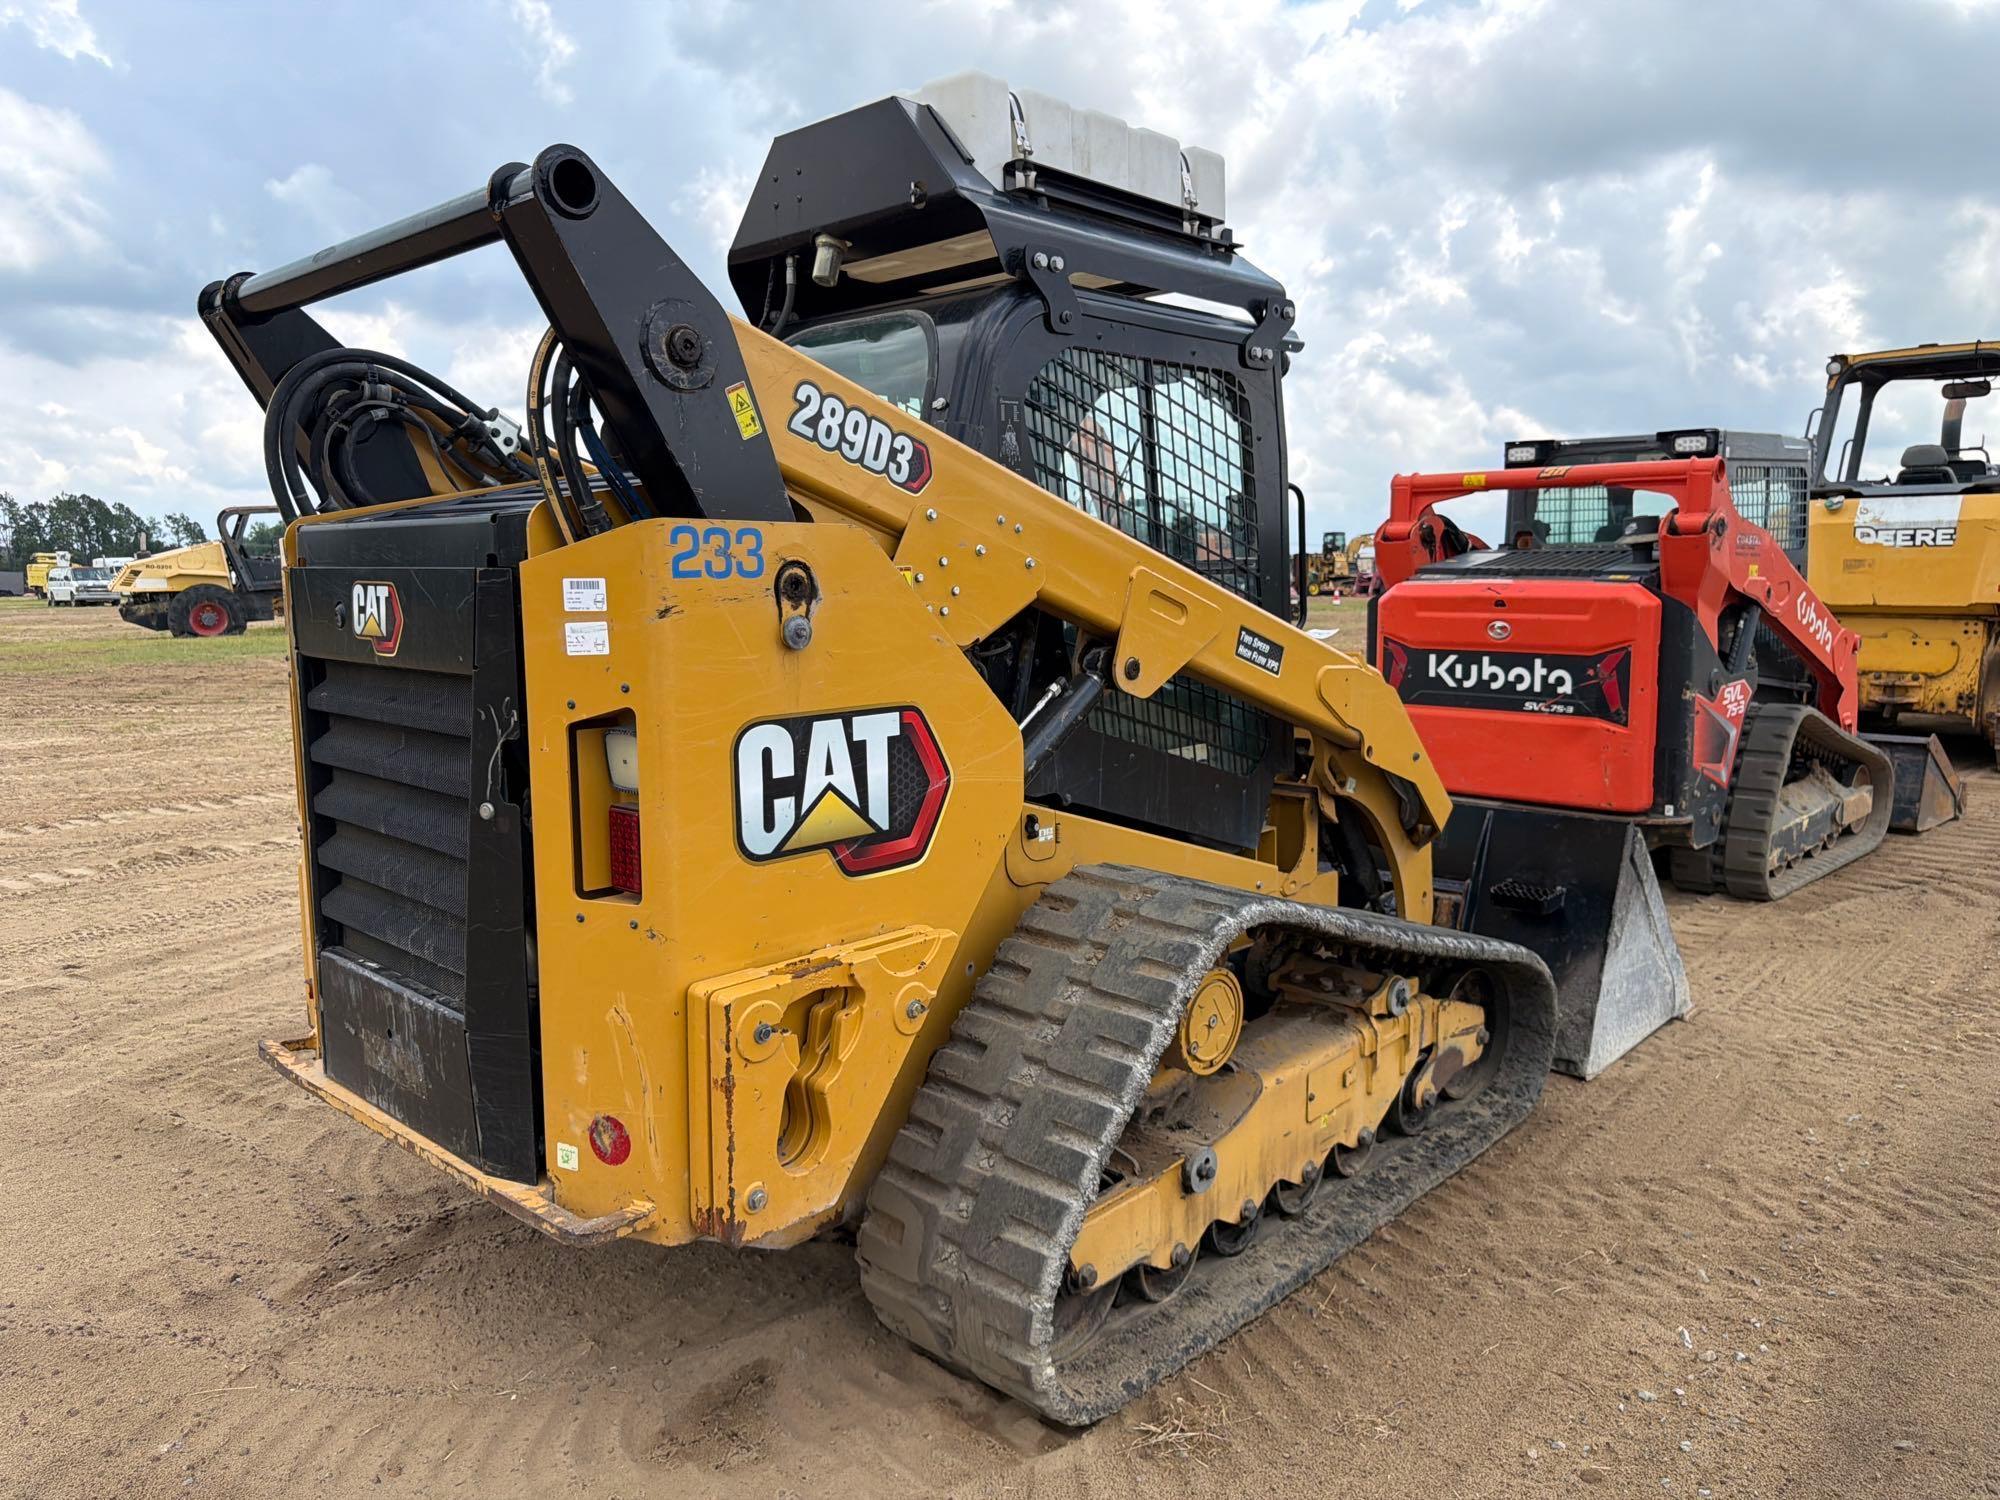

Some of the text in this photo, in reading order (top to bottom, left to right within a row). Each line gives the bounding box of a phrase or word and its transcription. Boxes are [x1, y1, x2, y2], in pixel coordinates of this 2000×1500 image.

[789, 382, 914, 485] 289D3
[669, 524, 765, 580] 233
[1854, 527, 1956, 548] DEERE
[352, 583, 389, 637] CAT
[1796, 590, 1833, 654] Kubota
[1266, 658, 1279, 672] XPS
[1428, 653, 1572, 695] Kubota
[1722, 684, 1744, 706] SVL
[1726, 700, 1745, 719] 75-3
[738, 711, 901, 855] CAT
